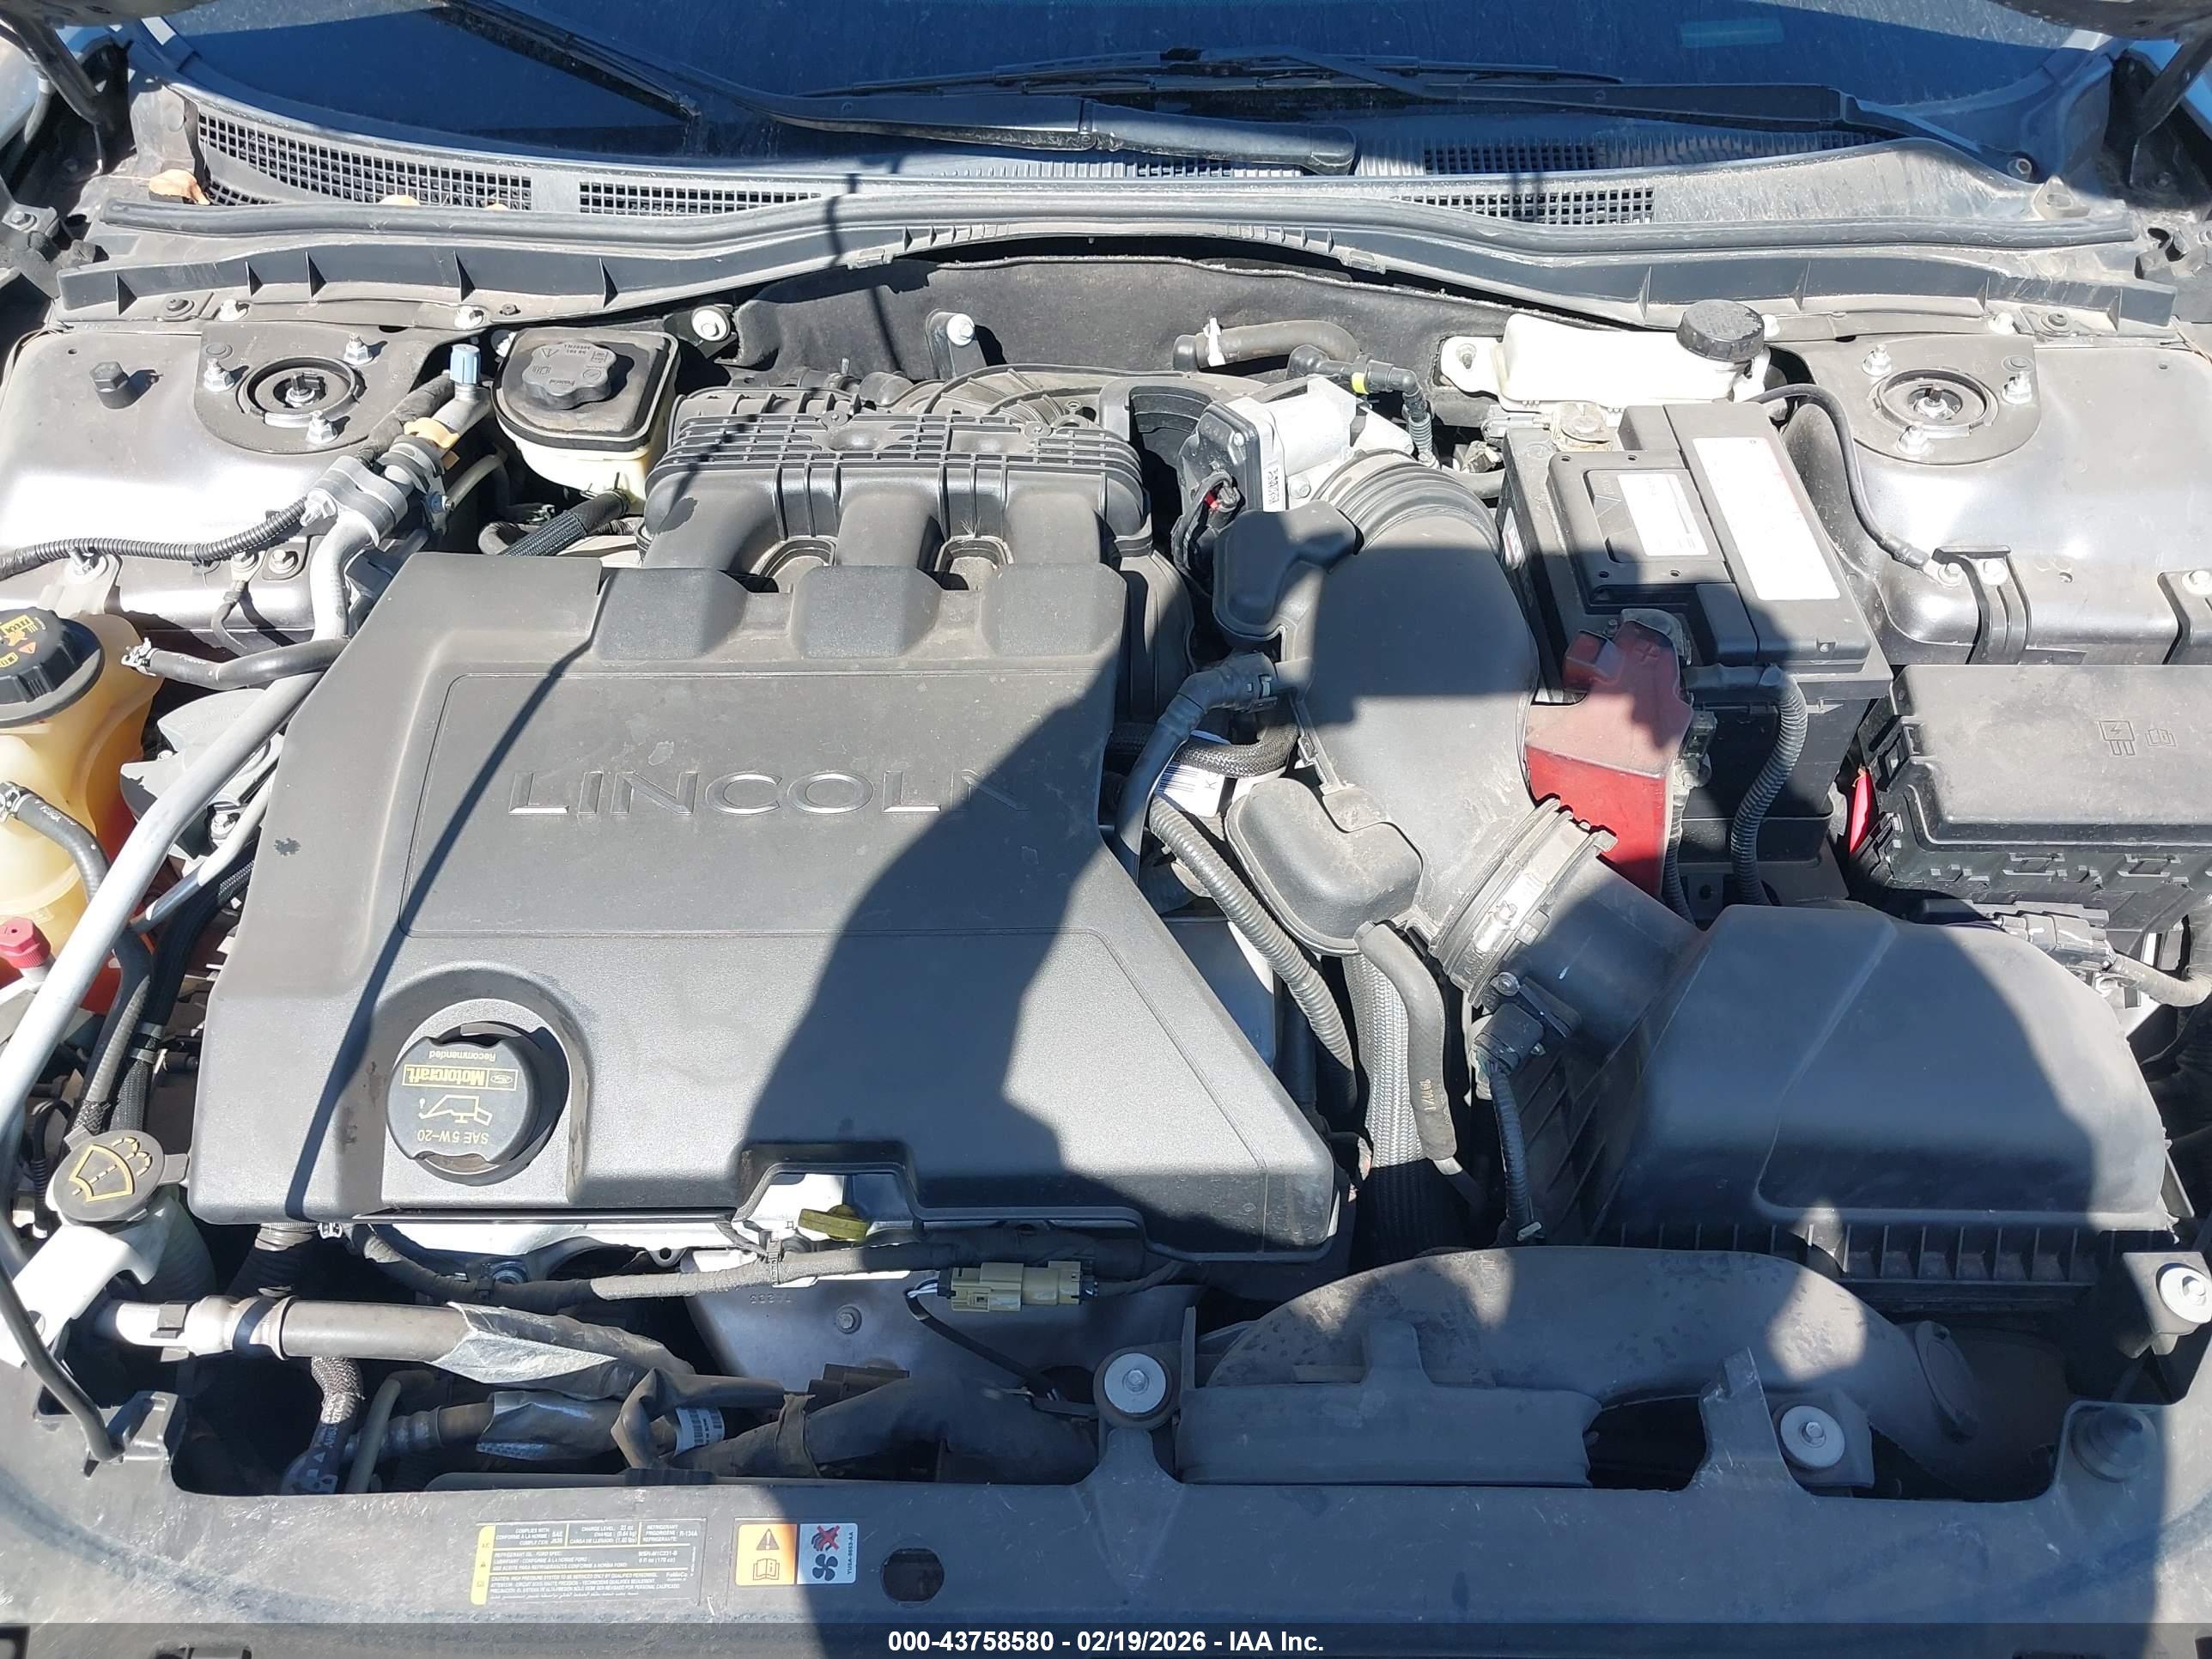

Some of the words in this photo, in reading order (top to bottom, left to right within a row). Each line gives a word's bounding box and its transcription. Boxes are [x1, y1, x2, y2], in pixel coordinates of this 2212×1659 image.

[508, 770, 1034, 816] LINCOLN
[429, 1051, 495, 1061] Recommended
[417, 1130, 460, 1143] 5W-20
[465, 1131, 489, 1144] SAE
